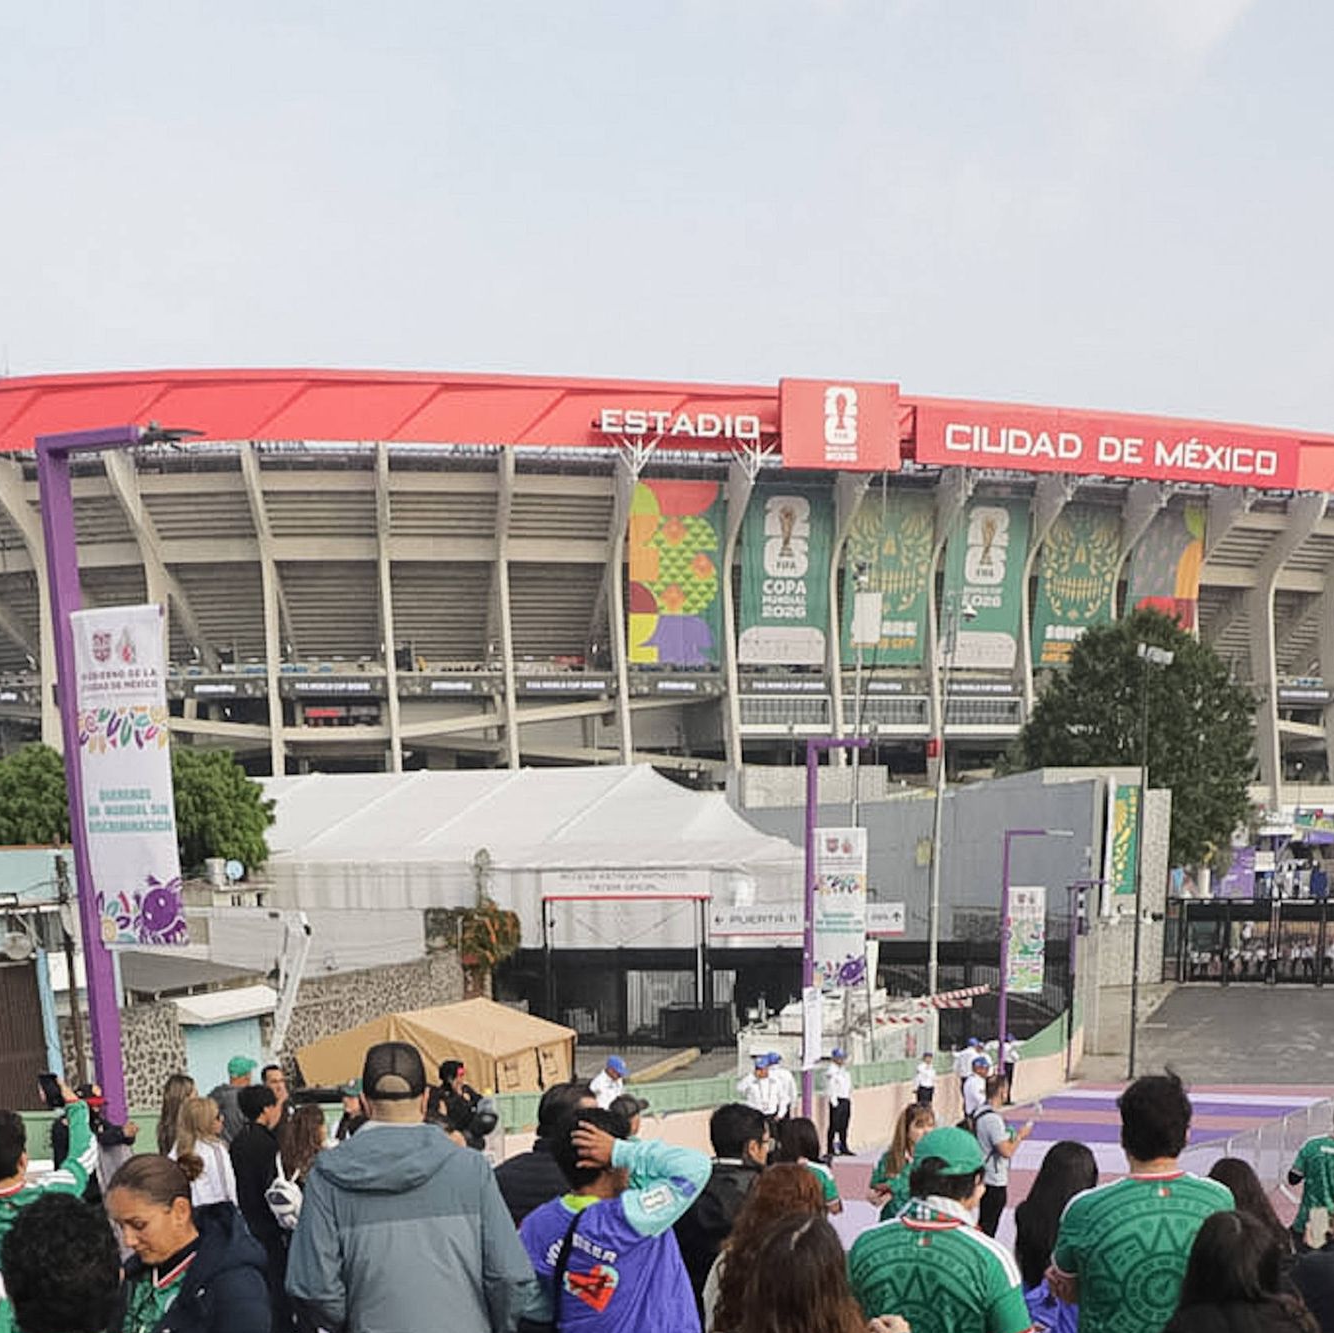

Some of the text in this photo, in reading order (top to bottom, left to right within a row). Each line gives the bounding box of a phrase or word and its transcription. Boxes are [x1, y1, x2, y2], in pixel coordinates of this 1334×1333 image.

[601, 409, 760, 439] ESTADIO
[944, 423, 1278, 475] CIUDAD DE MÉXICO
[762, 579, 806, 594] COPA
